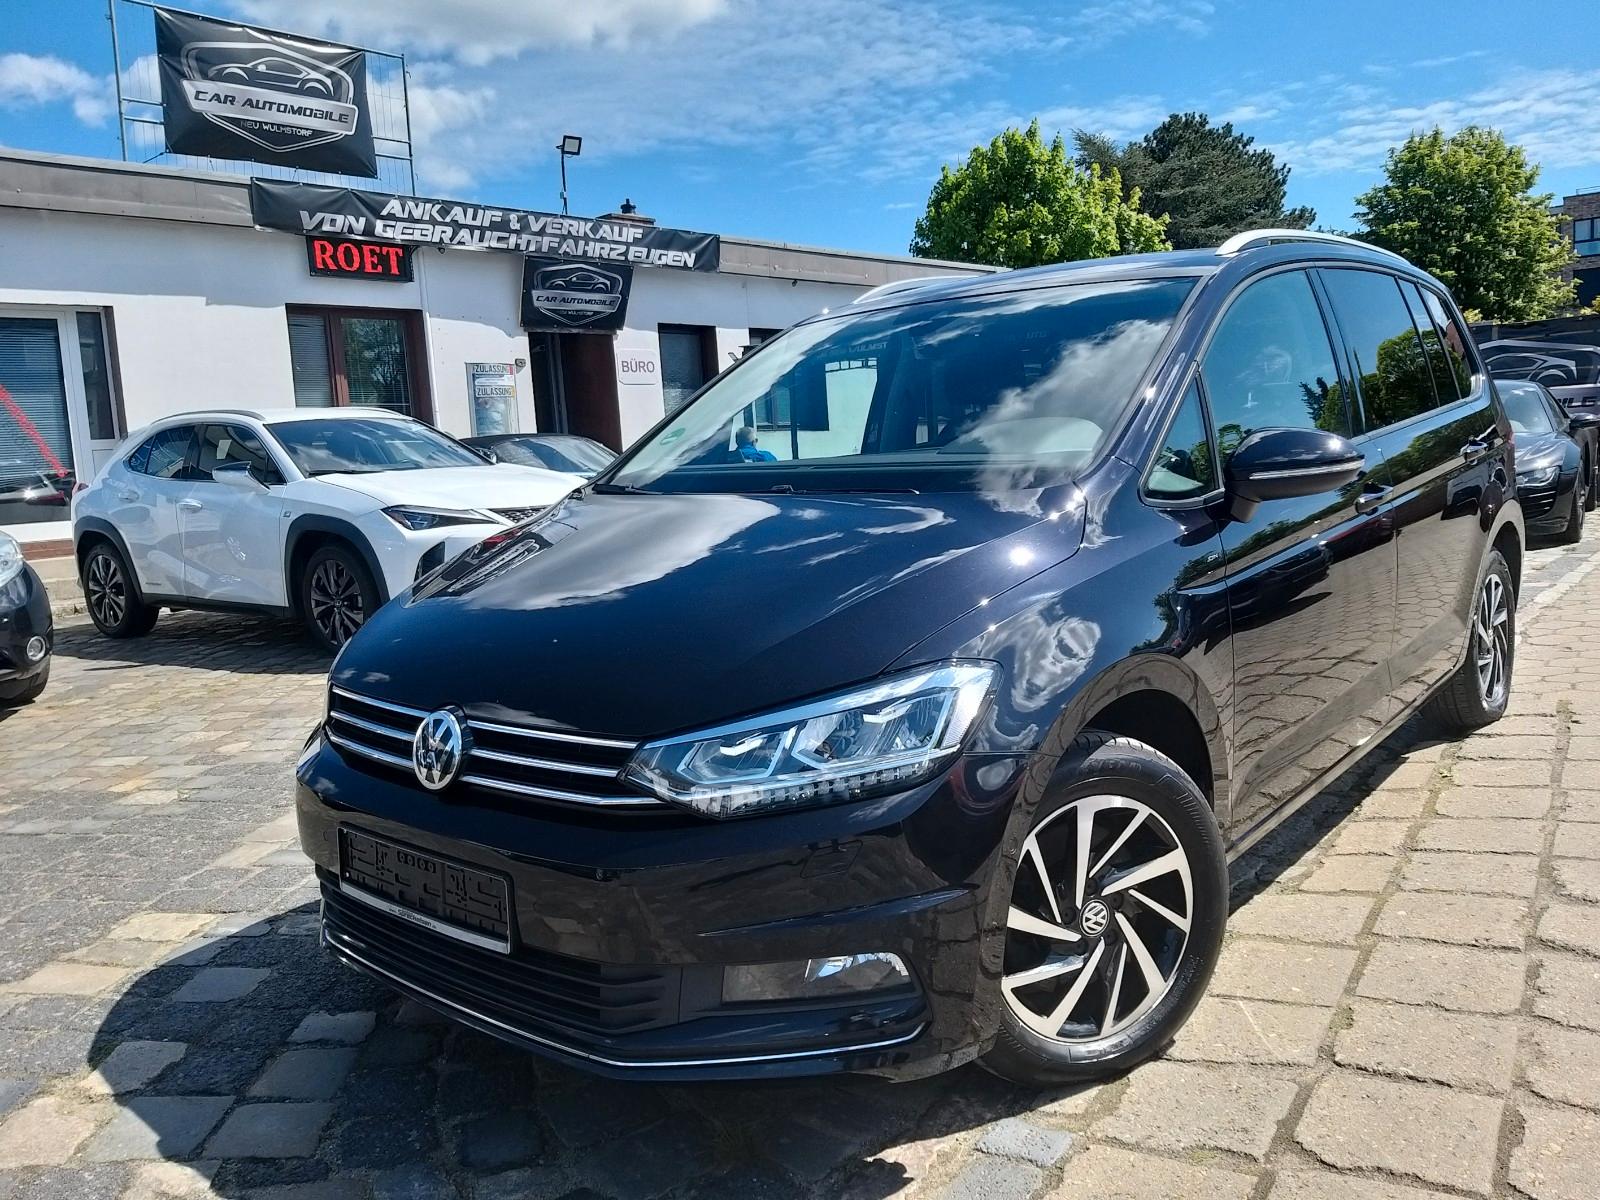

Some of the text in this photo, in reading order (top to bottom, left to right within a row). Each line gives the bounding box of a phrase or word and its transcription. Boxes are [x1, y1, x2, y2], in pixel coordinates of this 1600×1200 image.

[194, 90, 349, 124] CAR AUTOMOBILE
[240, 120, 313, 137] NEU WULMSTORF
[299, 210, 366, 235] VON
[380, 198, 644, 243] ANKAUF & VERKAUF
[313, 240, 403, 276] ROET
[536, 295, 616, 306] CAR AUTOMOBILE
[621, 357, 655, 373] BÜRO
[477, 387, 512, 396] ZULASSUNG
